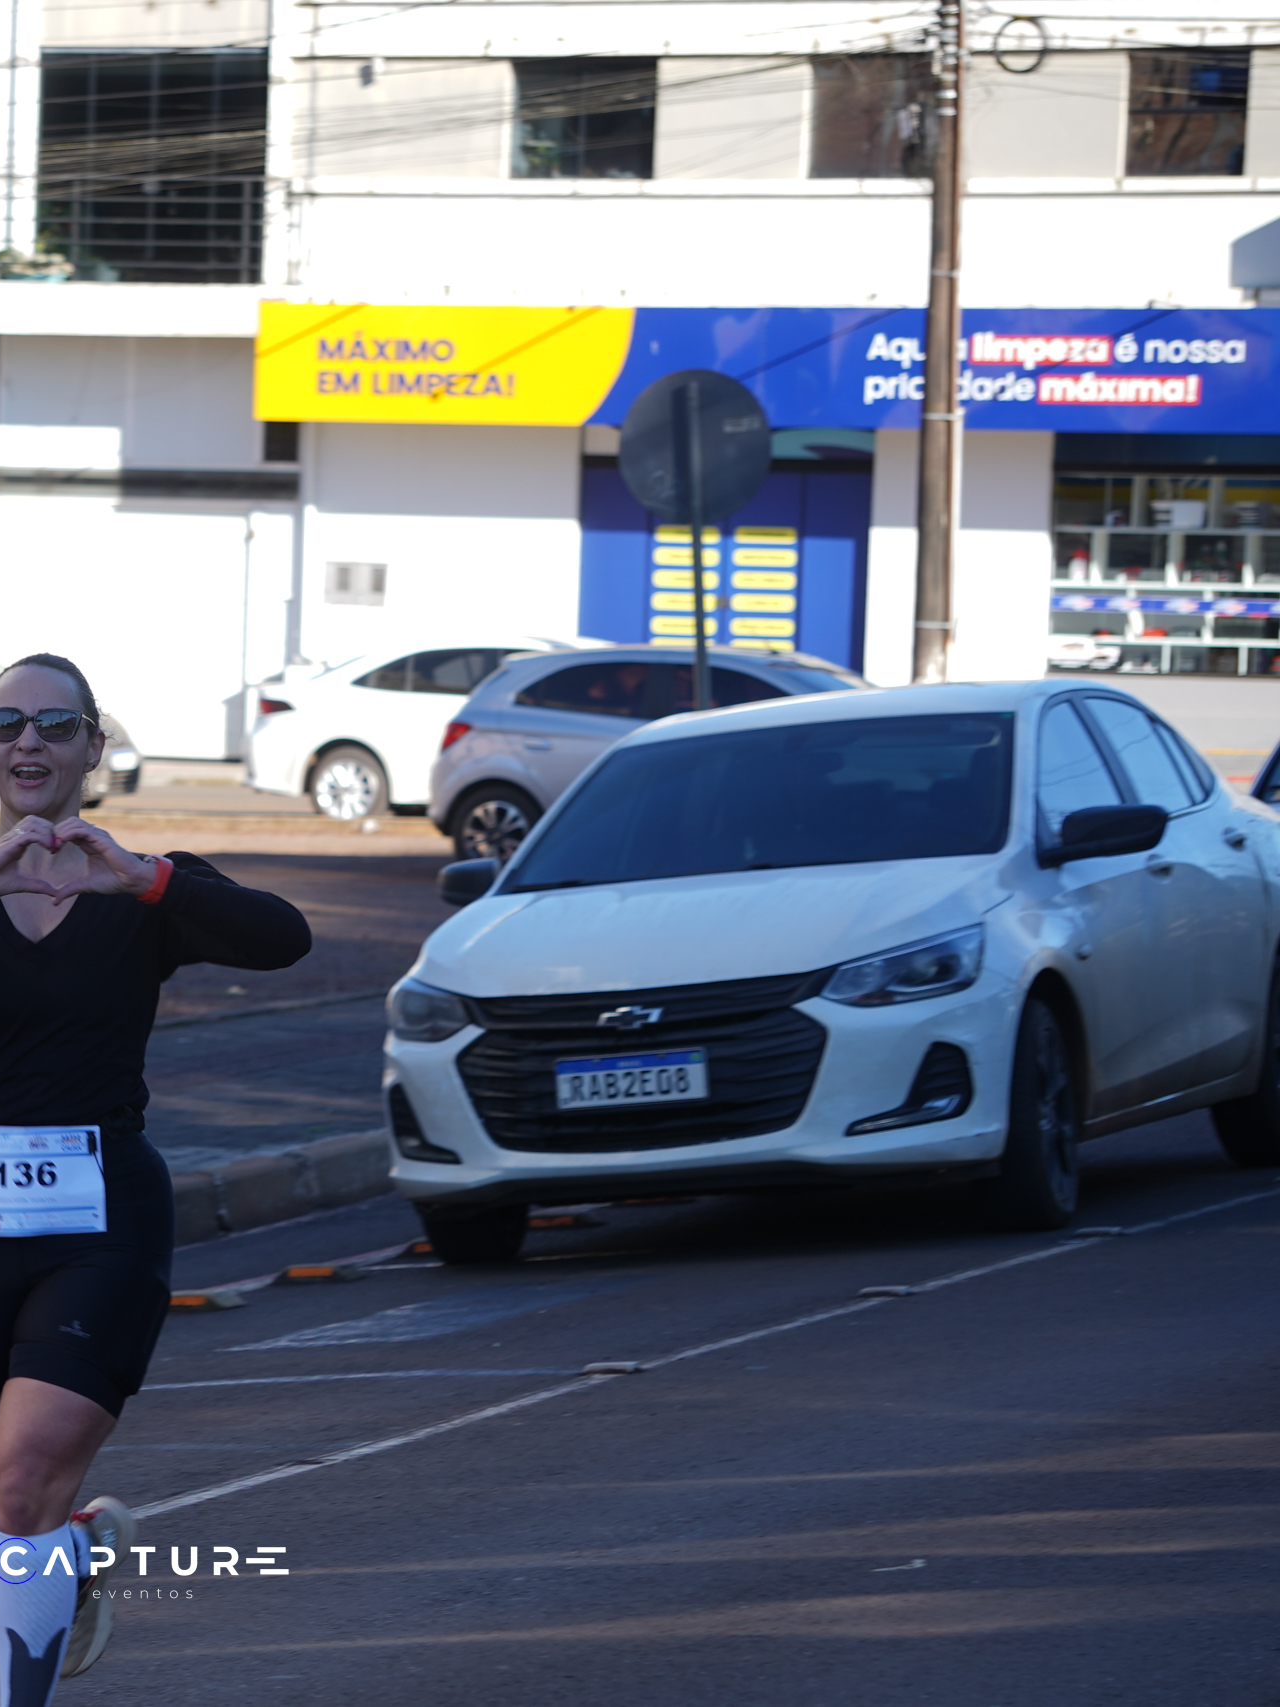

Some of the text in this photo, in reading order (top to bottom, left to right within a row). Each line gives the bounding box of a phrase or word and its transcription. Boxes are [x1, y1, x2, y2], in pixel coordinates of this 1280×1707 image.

[317, 330, 455, 362] MÁXIMO
[972, 331, 1110, 369] limpeza
[1113, 333, 1139, 363] é
[1143, 337, 1247, 364] nossa
[317, 371, 516, 398] EM LIMPEZA!
[1038, 371, 1200, 404] máxima!
[570, 1067, 691, 1102] RAB2E08
